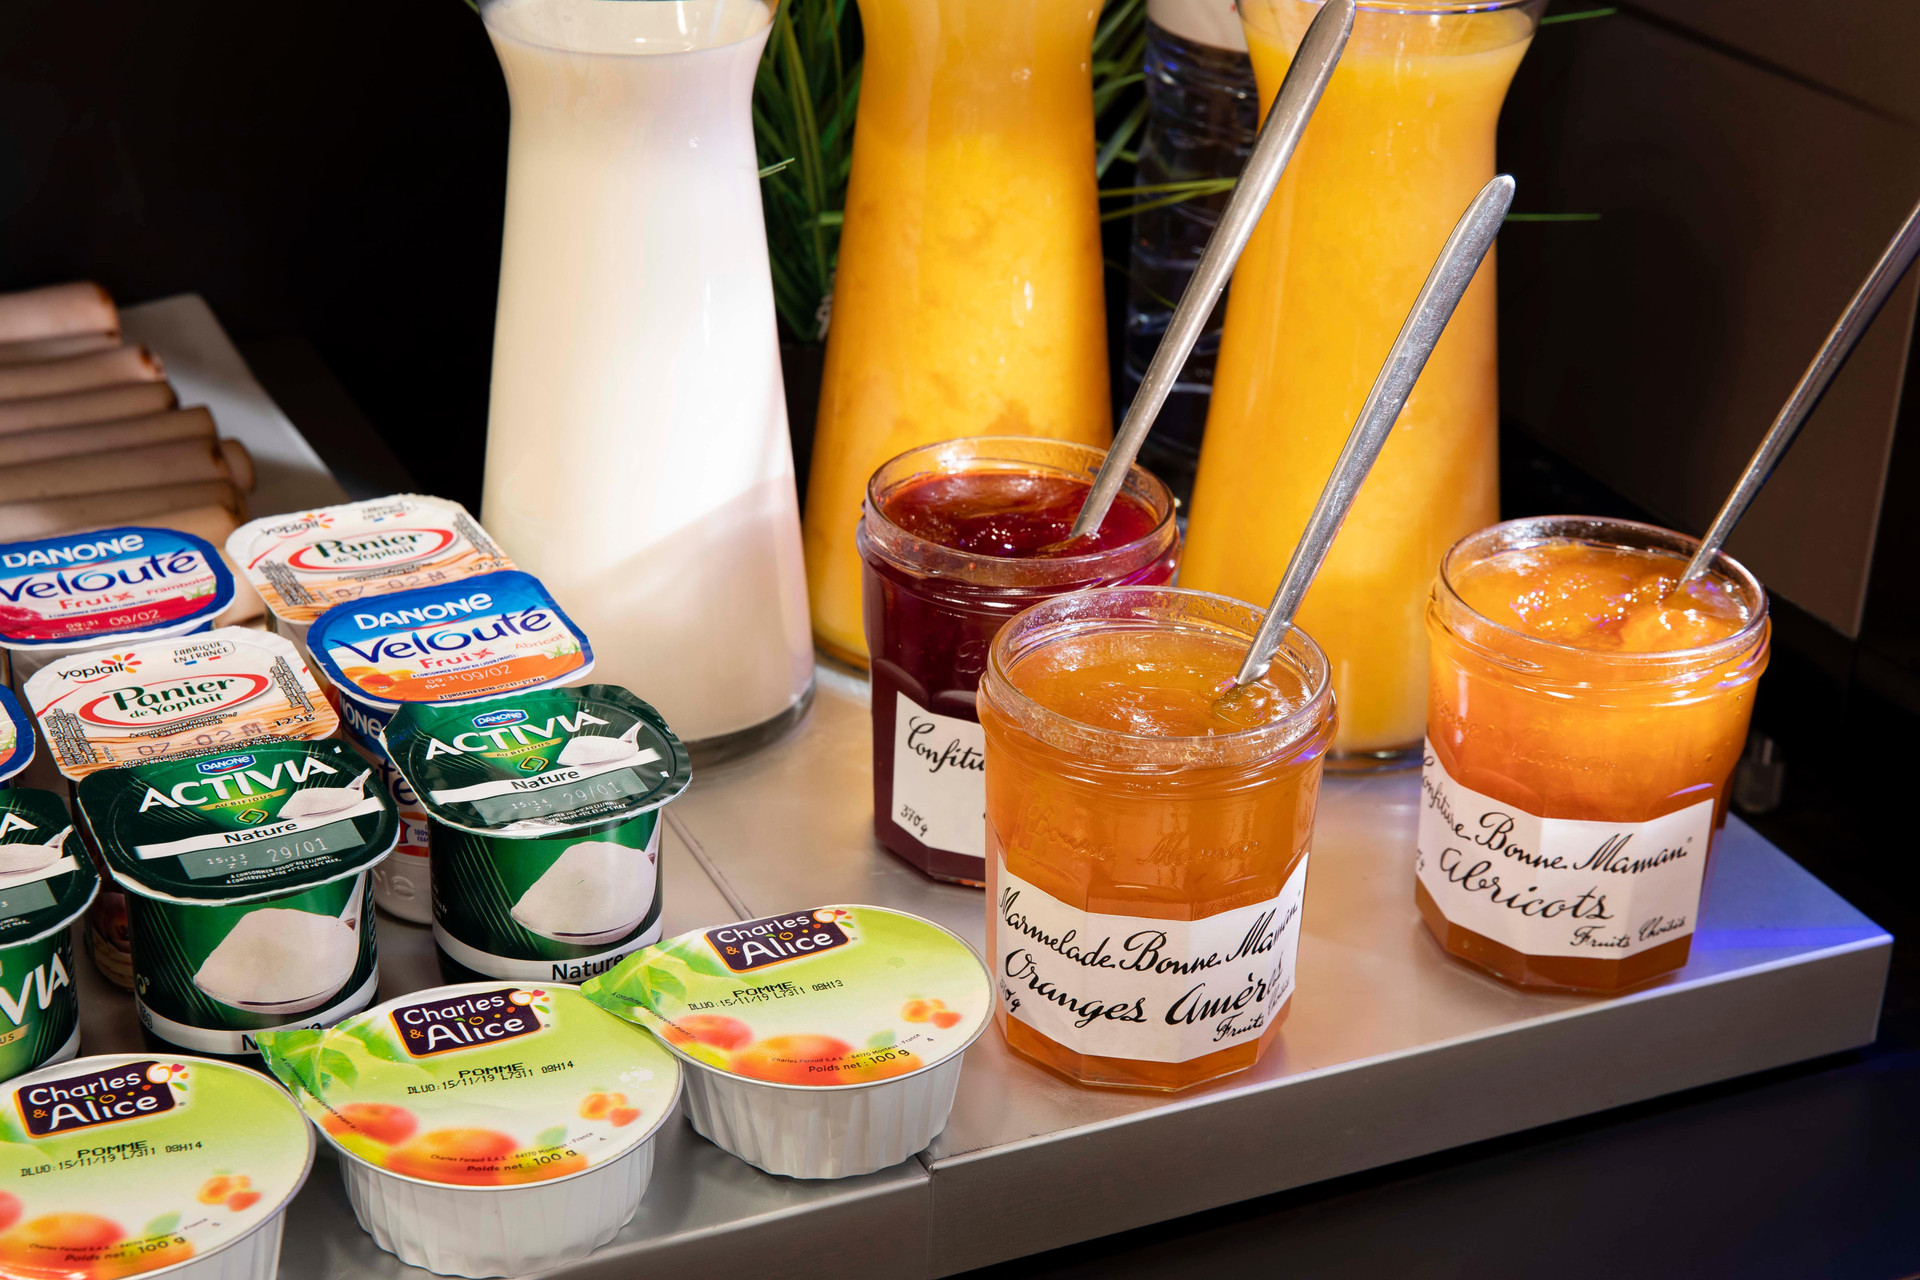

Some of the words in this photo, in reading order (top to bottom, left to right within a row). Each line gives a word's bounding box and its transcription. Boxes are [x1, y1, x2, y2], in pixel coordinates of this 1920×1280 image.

[2, 534, 145, 568] DANONE
[311, 533, 422, 558] Panier
[347, 545, 416, 563] Yoplait
[0, 548, 199, 602] Velouté
[146, 574, 214, 596] Framboise
[109, 609, 160, 626] 09/02
[353, 592, 493, 630] DANONE
[329, 605, 551, 663] Velouté
[515, 632, 566, 651] Abricot
[173, 641, 222, 656] FABRIQUE
[173, 656, 187, 664] EN
[191, 646, 228, 662] FRANCE
[57, 659, 125, 680] yoplait
[460, 664, 512, 682] 09/02
[103, 678, 235, 711] Panier
[130, 709, 148, 719] de
[147, 691, 223, 717] Yoplait
[241, 722, 263, 738] M
[274, 714, 316, 727] 125g
[476, 712, 523, 726] DANONE
[425, 709, 609, 760] ACTIVIA
[201, 755, 250, 770] DANONE
[138, 757, 338, 813] ACTIVIA
[511, 769, 580, 790] Nature
[230, 793, 275, 806] BIFIDUS
[563, 781, 622, 804] 29/01
[225, 821, 298, 844] Nature
[1475, 811, 1567, 870] Bonne
[1573, 832, 1688, 874] Maman
[266, 837, 328, 862] 29/01
[235, 868, 274, 878] CONSOMMER
[1440, 847, 1614, 920] Abricots
[717, 913, 810, 943] Charles
[999, 887, 1116, 968] Marmelade
[1119, 931, 1221, 975] Bonne
[1570, 925, 1631, 950] Fruits
[726, 945, 740, 955] &
[745, 930, 833, 966] Alice
[552, 953, 624, 980] Nature
[732, 981, 796, 998] POMME
[1005, 948, 1147, 1028] Oranges
[403, 994, 505, 1025] Charles
[410, 1028, 424, 1039] &
[428, 1015, 525, 1051] Alice
[1213, 1011, 1264, 1042] Fruits
[901, 1033, 921, 1045] France
[459, 1062, 524, 1078] POMME
[809, 1064, 840, 1073] Poids
[843, 1062, 862, 1070] net
[869, 1052, 896, 1065] 100
[898, 1049, 910, 1057] g
[28, 1071, 141, 1106] Charles
[33, 1108, 48, 1118] &
[49, 1093, 158, 1130] Alice
[77, 1140, 148, 1158] POMME
[533, 1153, 562, 1166] 100
[566, 1149, 577, 1157] g
[138, 1241, 169, 1254] 100
[174, 1236, 186, 1244] g
